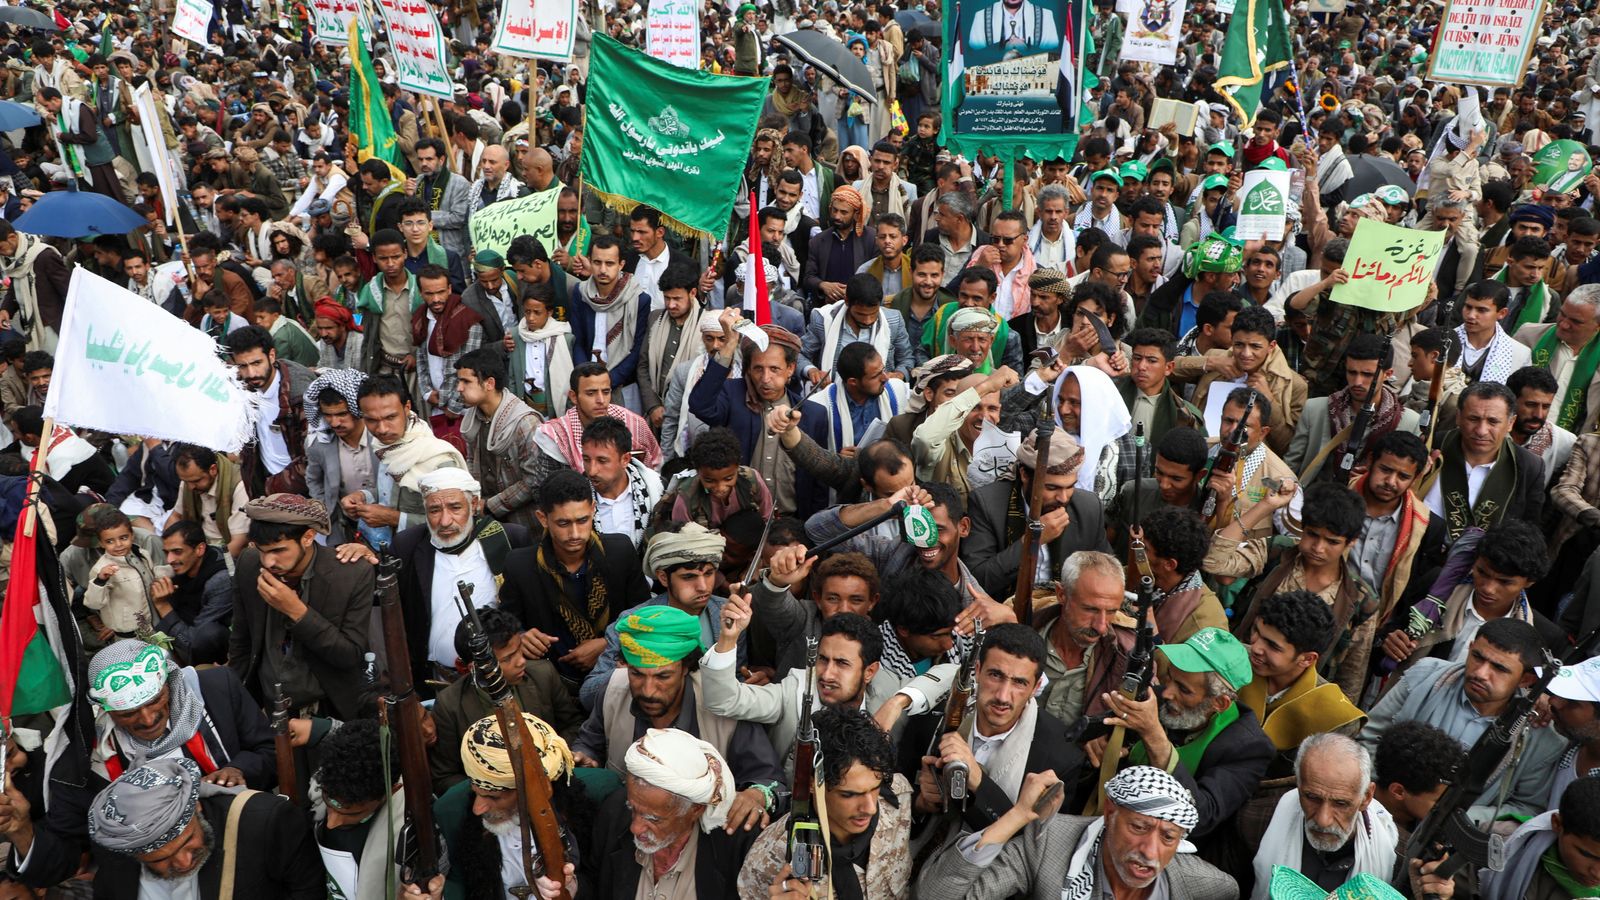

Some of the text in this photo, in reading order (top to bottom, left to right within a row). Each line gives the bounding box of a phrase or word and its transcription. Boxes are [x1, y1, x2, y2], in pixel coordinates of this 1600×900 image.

[677, 4, 694, 16] الله
[1448, 12, 1524, 28] DEATH TO ISRAEL
[1480, 32, 1494, 46] ON
[1495, 34, 1520, 47] JEWS
[1439, 48, 1518, 75] VICTORY FOR ISLAM
[608, 102, 626, 122] الله
[699, 128, 726, 151] لبيك
[1384, 238, 1424, 264] غزة
